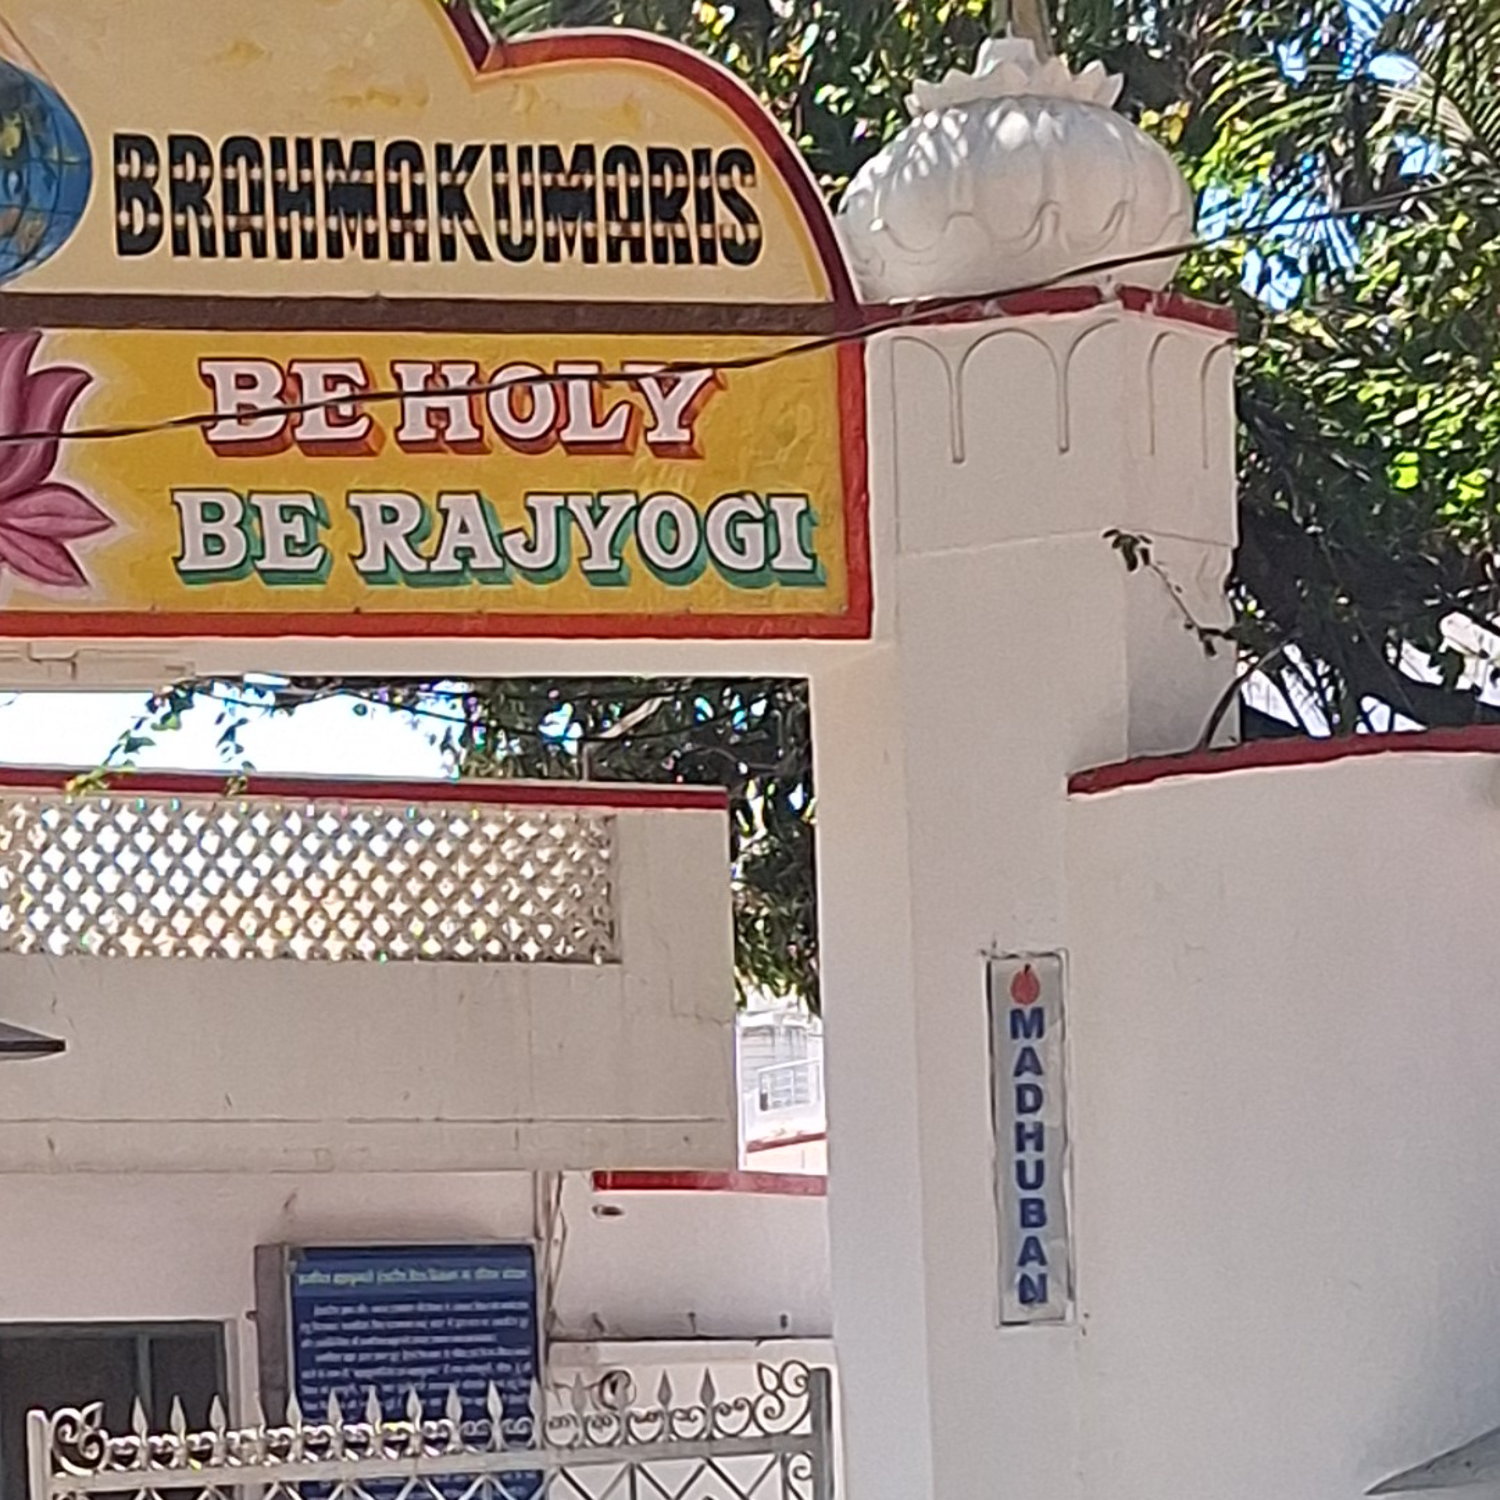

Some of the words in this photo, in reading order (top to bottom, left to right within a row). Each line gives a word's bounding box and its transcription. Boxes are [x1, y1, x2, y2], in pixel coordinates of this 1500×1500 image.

[112, 132, 764, 267] BRAHMAKUMARIS
[199, 356, 380, 458] BE
[394, 358, 722, 460] HOLY
[172, 488, 332, 588] BE
[347, 490, 826, 588] RAJYOGI
[1008, 1005, 1050, 1306] MADHUBAN
